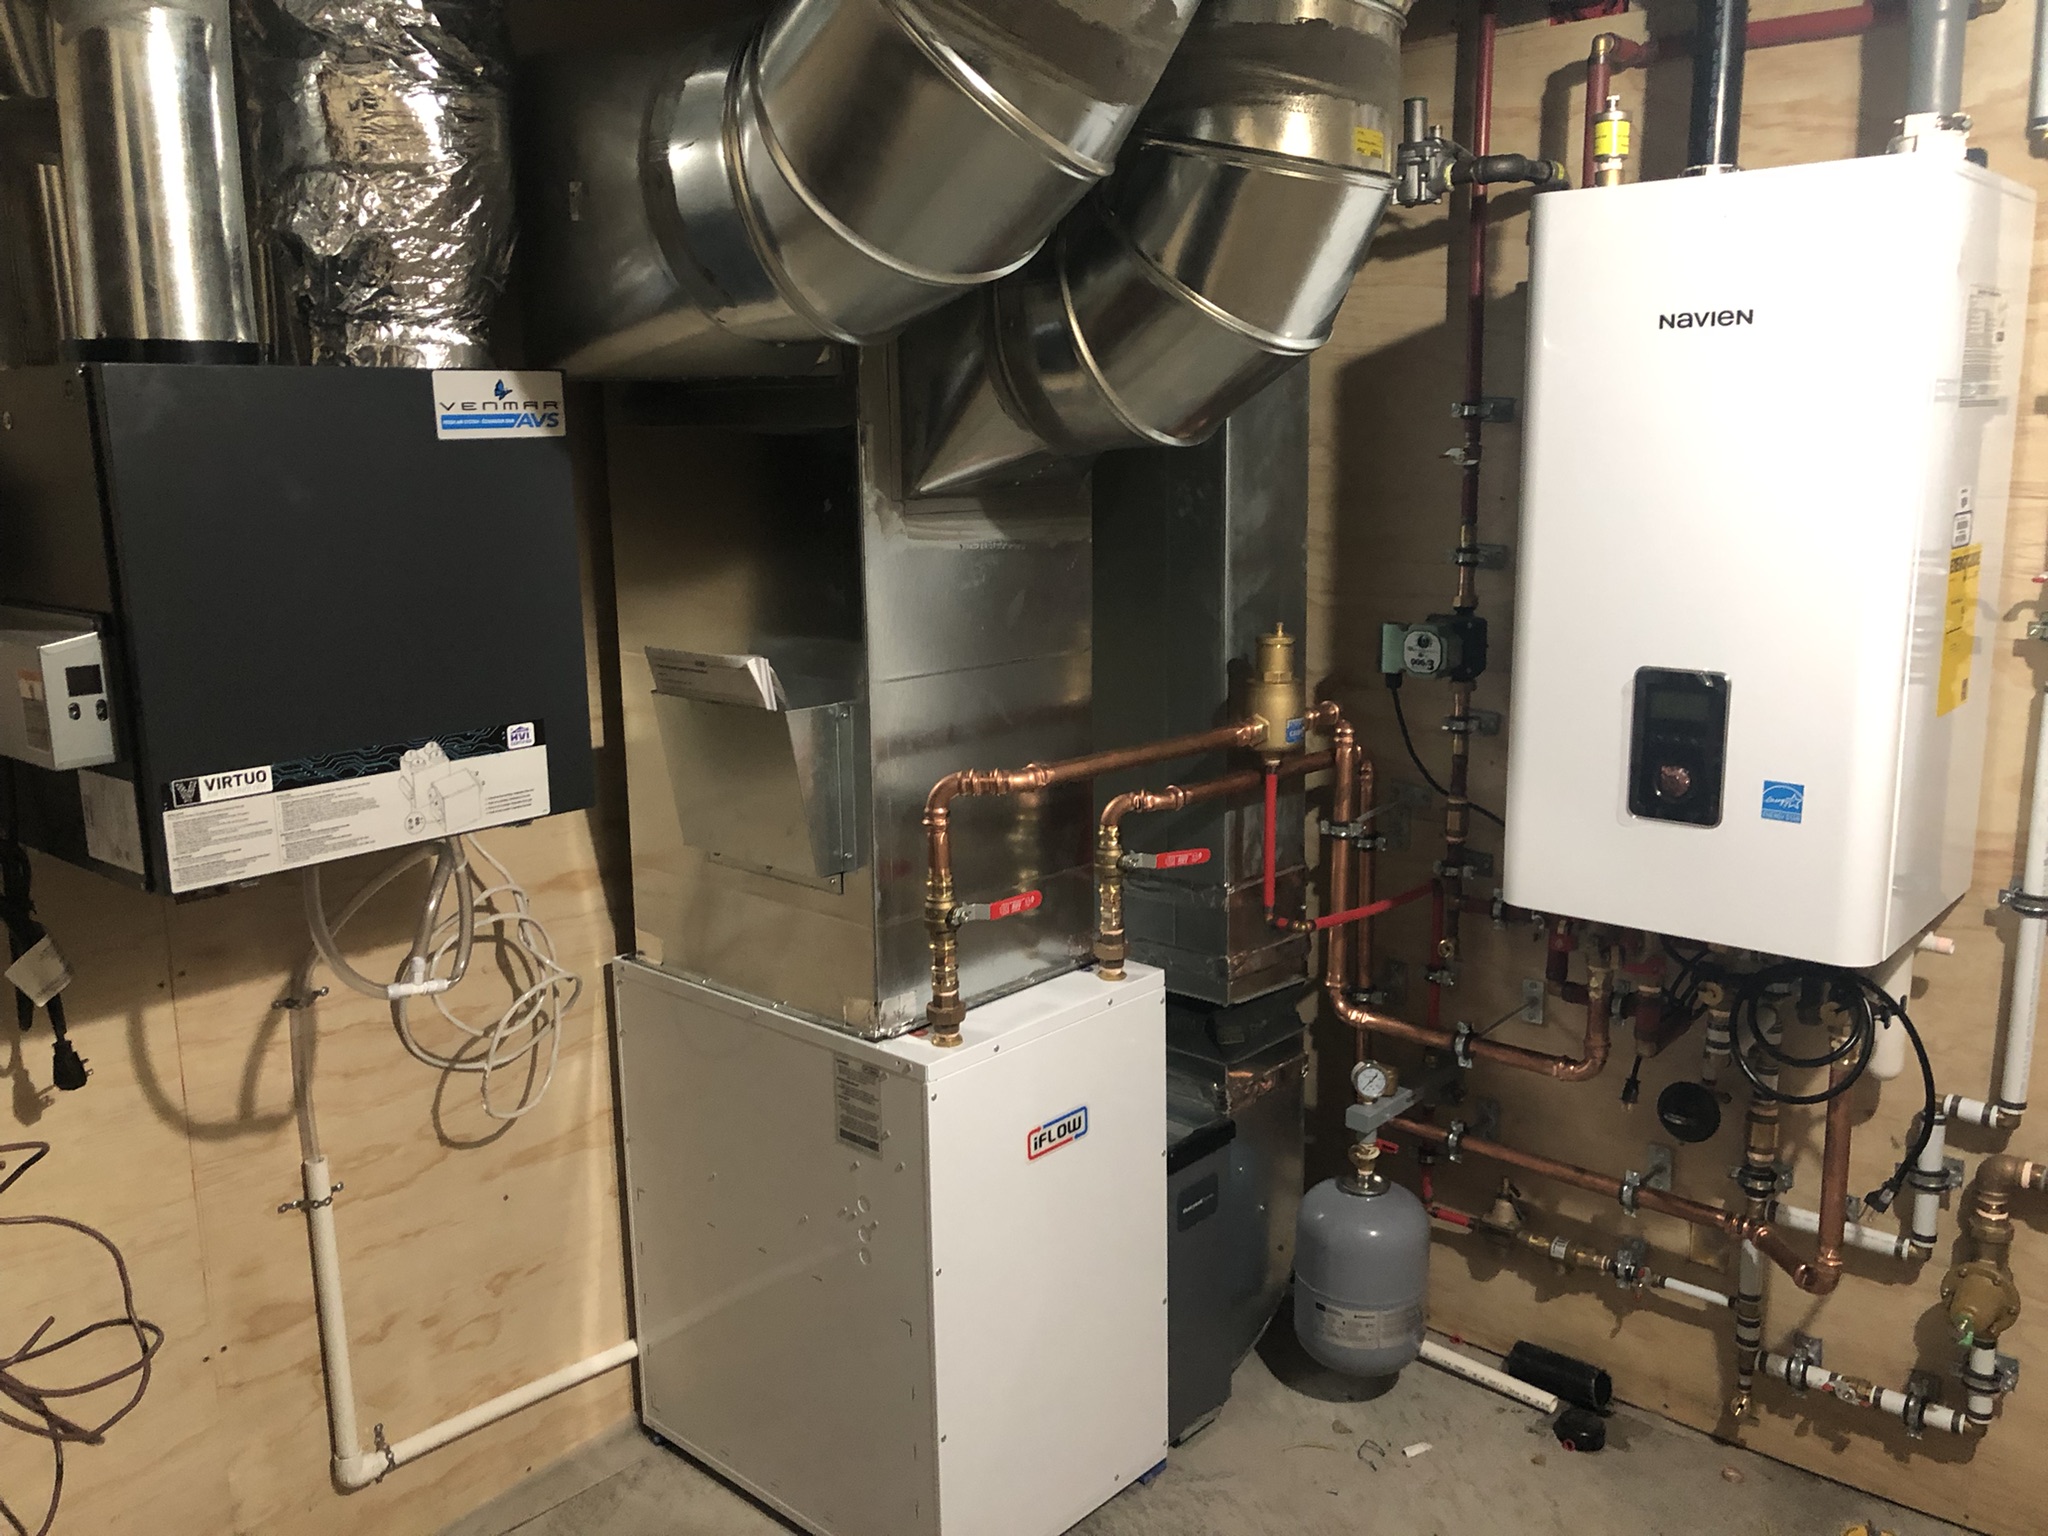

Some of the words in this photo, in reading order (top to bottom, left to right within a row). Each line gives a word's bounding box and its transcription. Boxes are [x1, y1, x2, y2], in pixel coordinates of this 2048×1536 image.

[439, 401, 559, 411] VENMAR
[515, 412, 560, 428] AVS
[511, 732, 530, 741] HVI
[204, 770, 267, 791] VIRTUO
[1033, 1115, 1082, 1151] iFLOW
